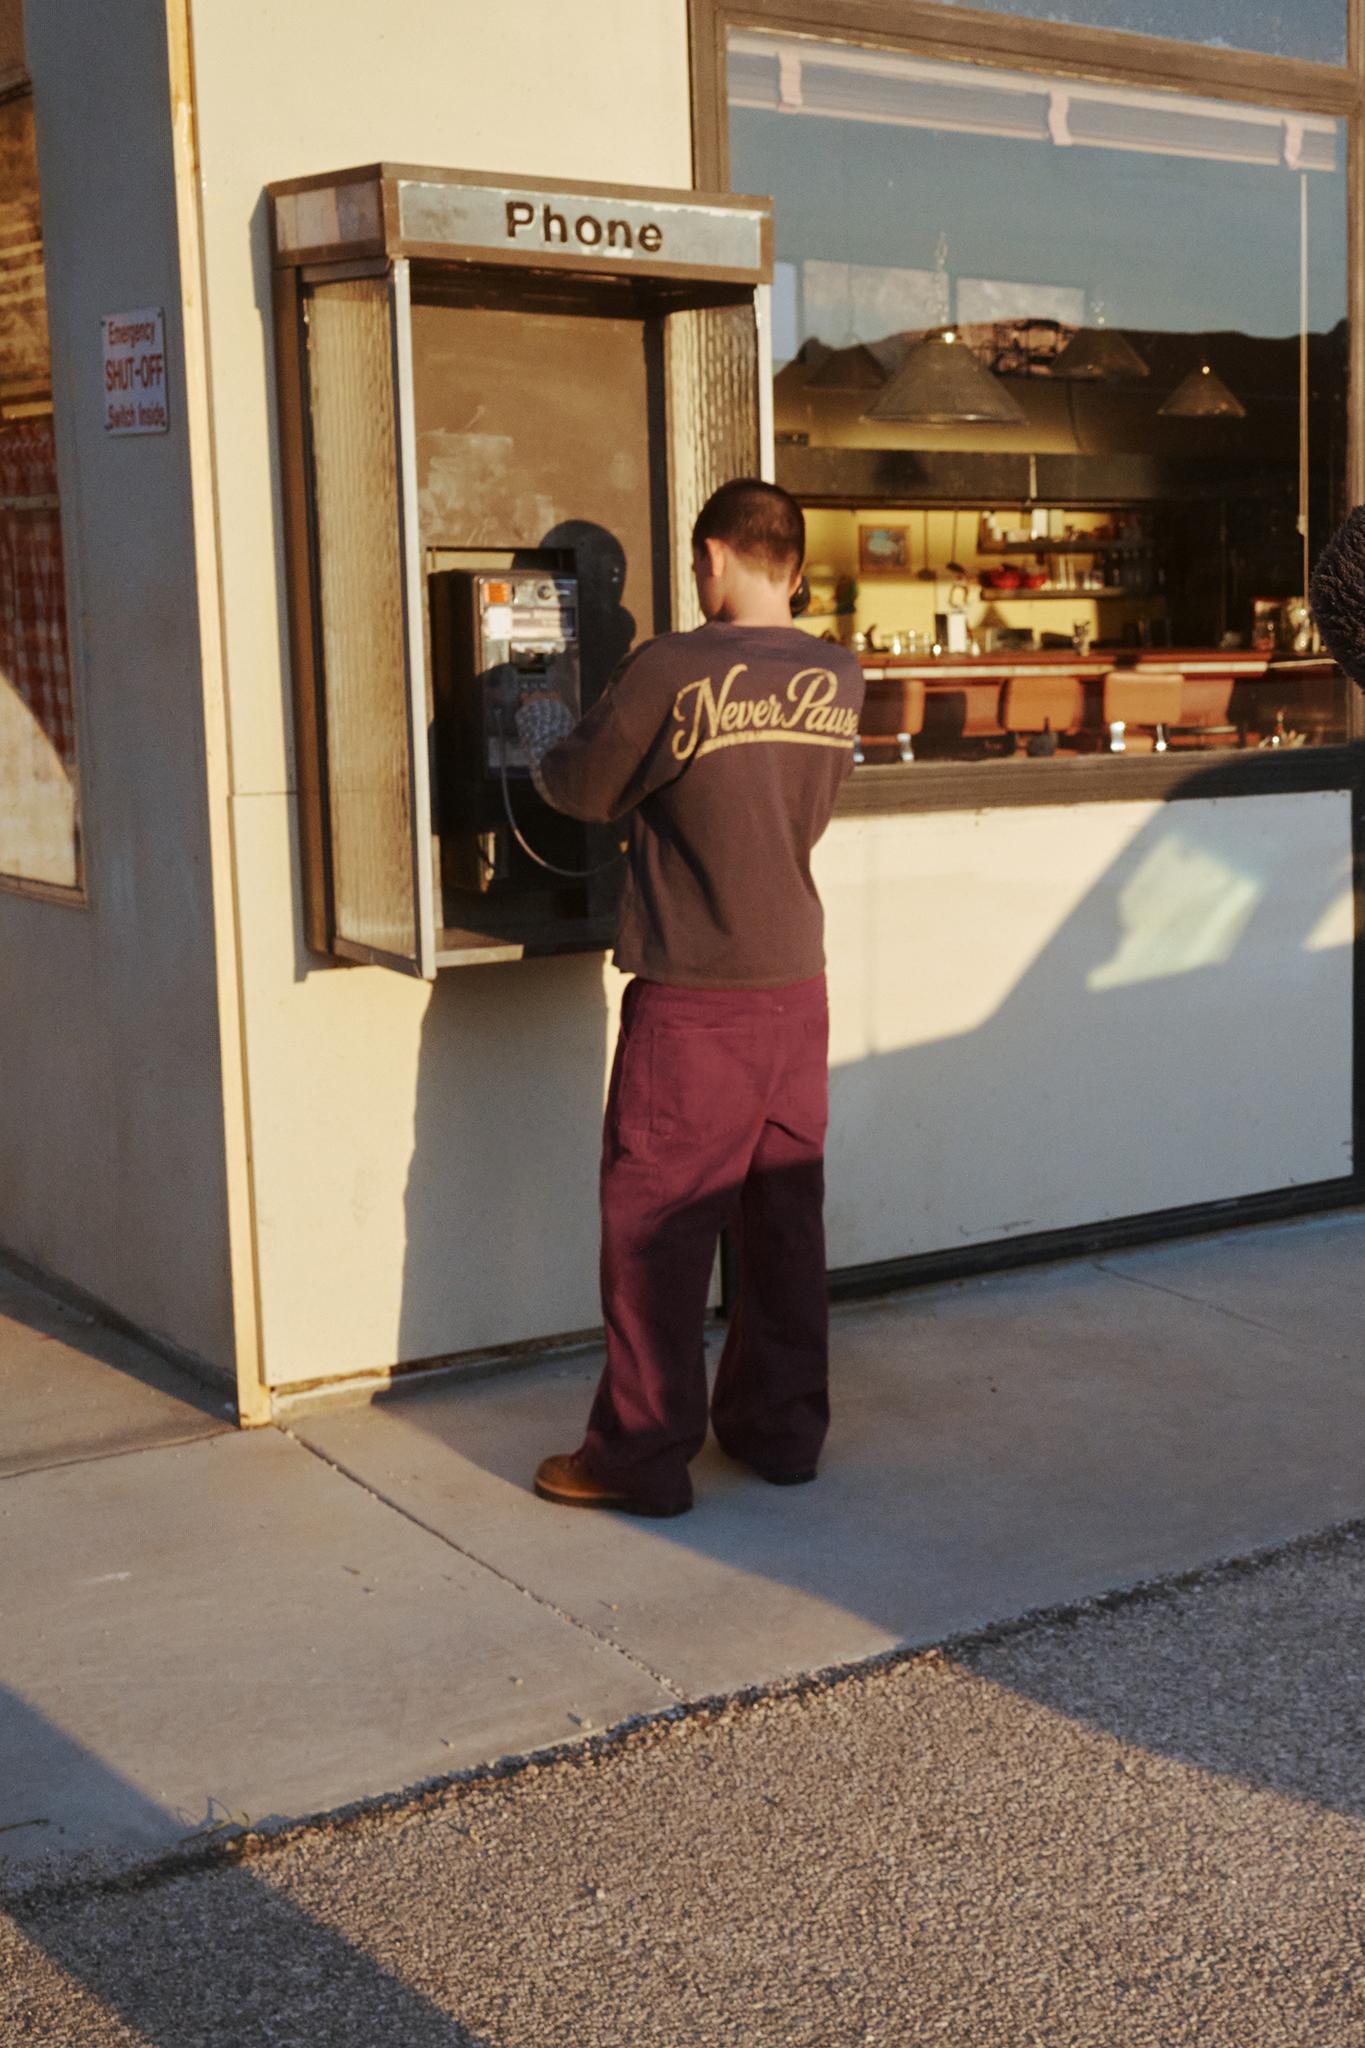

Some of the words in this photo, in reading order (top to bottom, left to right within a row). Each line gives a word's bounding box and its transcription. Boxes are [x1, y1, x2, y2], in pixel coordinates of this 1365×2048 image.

[505, 201, 663, 252] Phone
[108, 320, 155, 348] Emergency
[106, 353, 163, 392] SHUT-OFF
[108, 404, 134, 428] Switch
[138, 402, 165, 426] Inside
[672, 664, 783, 760] Never
